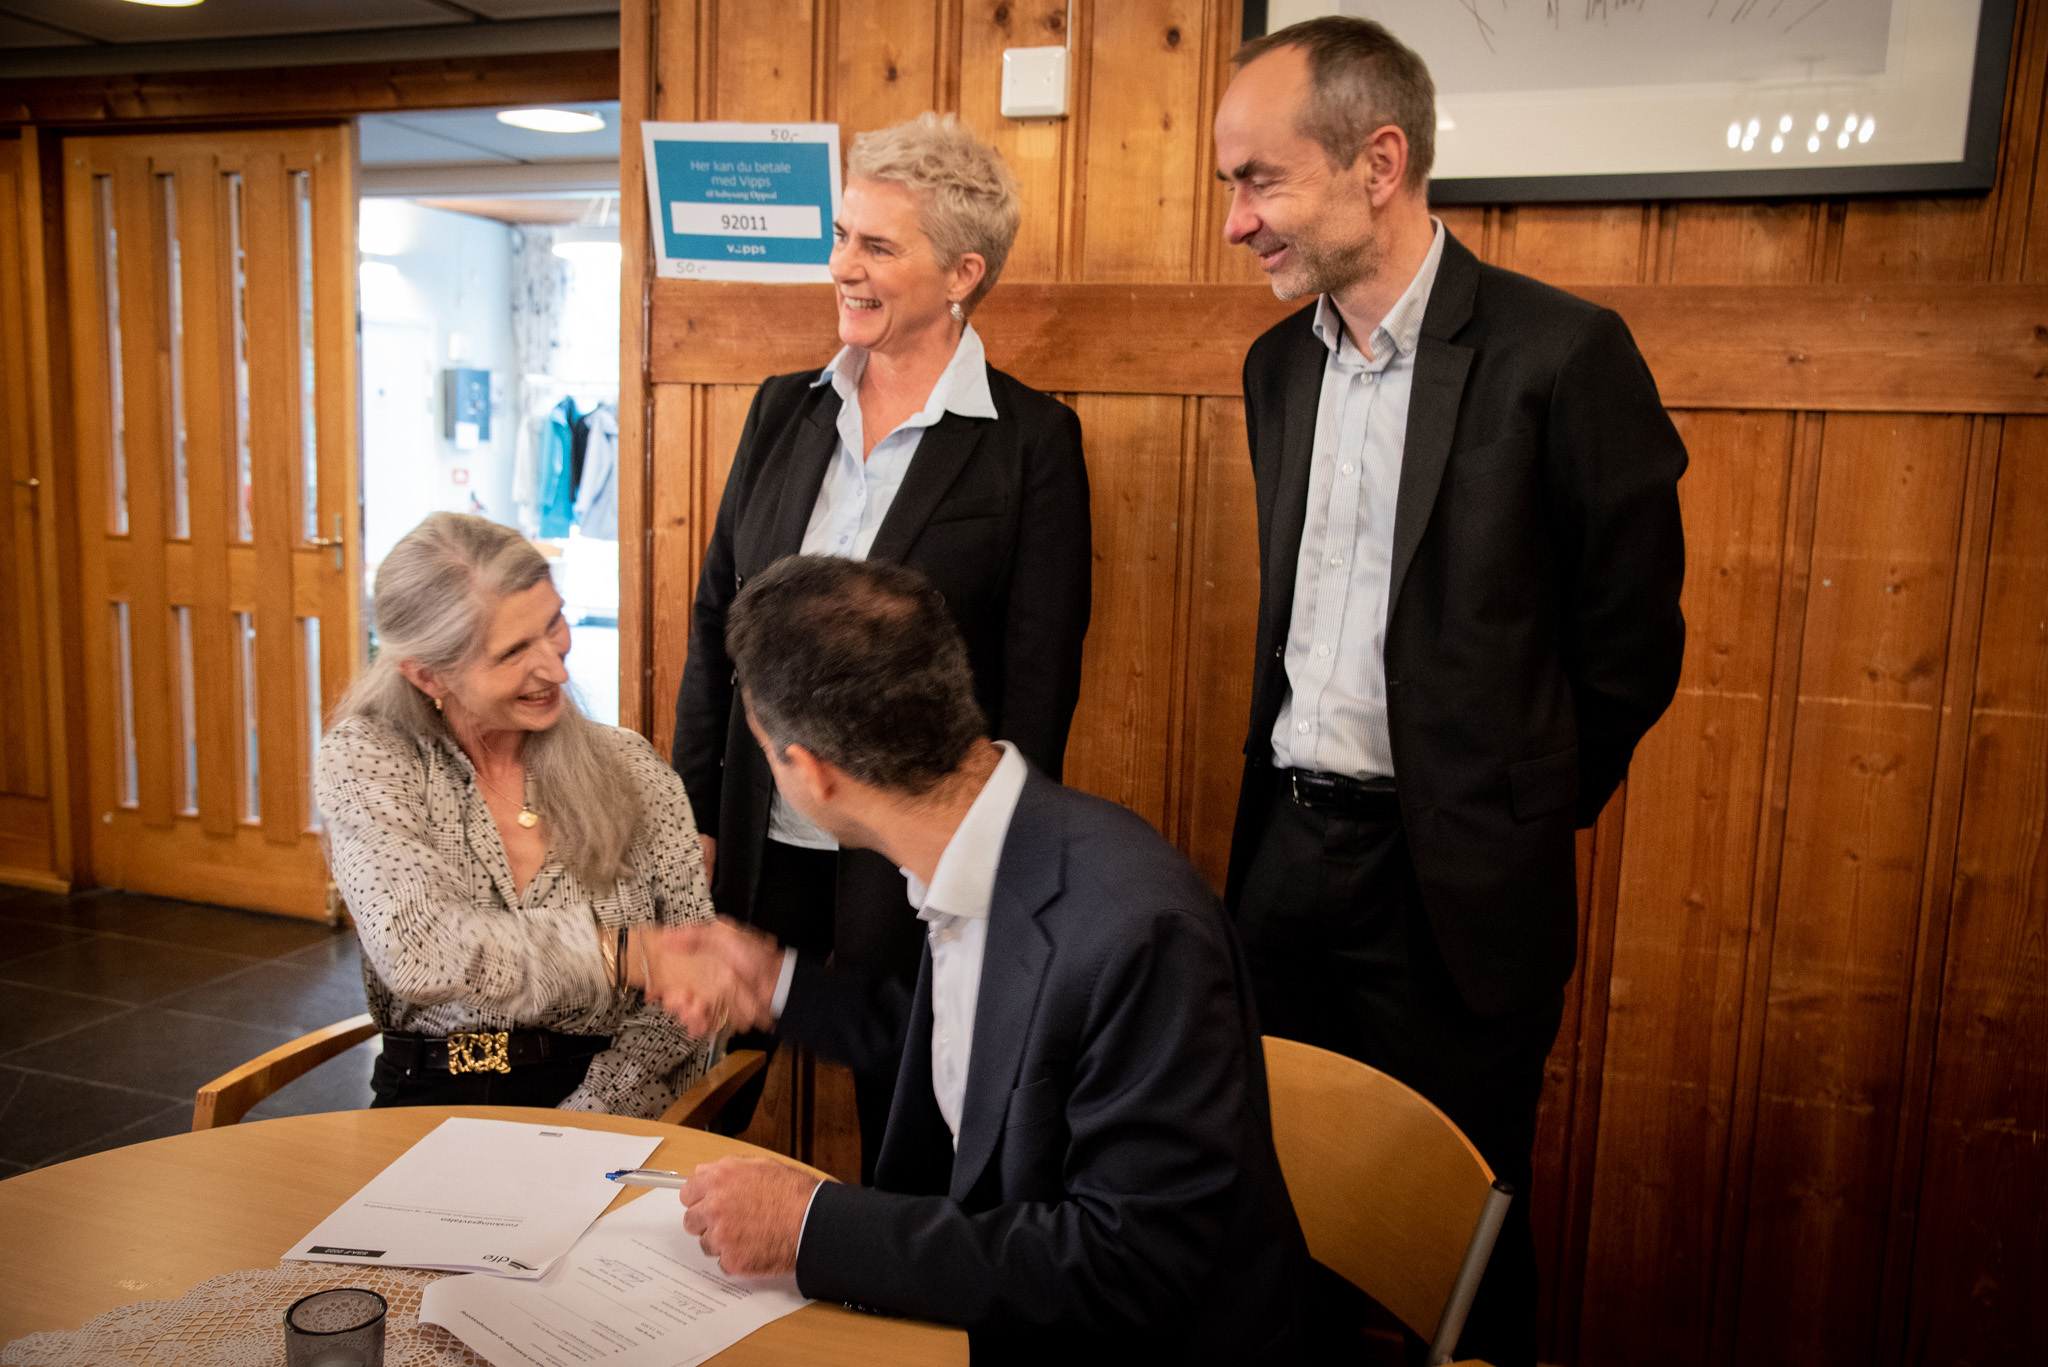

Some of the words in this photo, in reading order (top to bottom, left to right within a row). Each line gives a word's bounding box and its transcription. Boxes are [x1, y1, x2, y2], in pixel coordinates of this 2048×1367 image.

[690, 160, 711, 172] Her
[713, 161, 735, 173] kan
[737, 161, 752, 173] du
[754, 161, 791, 174] betale
[711, 175, 737, 187] med
[739, 176, 772, 190] Vipps
[721, 214, 768, 231] 92011
